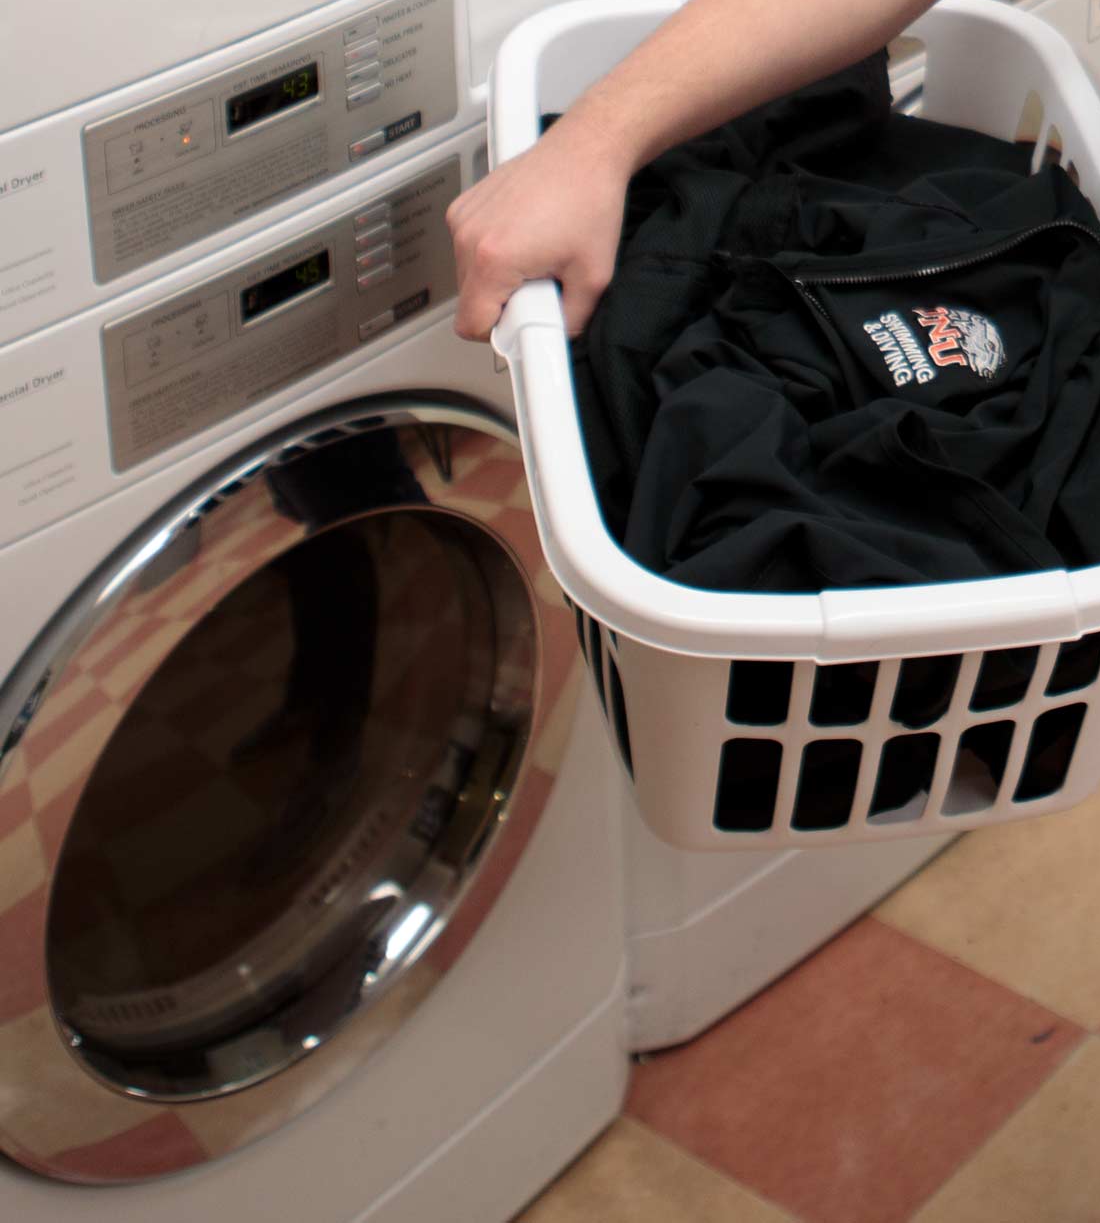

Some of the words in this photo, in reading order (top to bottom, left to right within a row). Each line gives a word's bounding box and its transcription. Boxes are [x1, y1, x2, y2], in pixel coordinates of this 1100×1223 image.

[283, 70, 309, 98] 43
[134, 106, 186, 133] PROCESSING
[388, 117, 417, 139] START
[11, 169, 44, 190] Dryer
[863, 322, 882, 334] &
[871, 331, 913, 387] DIVING
[880, 313, 935, 384] SWIMMING
[32, 368, 64, 388] Dryer
